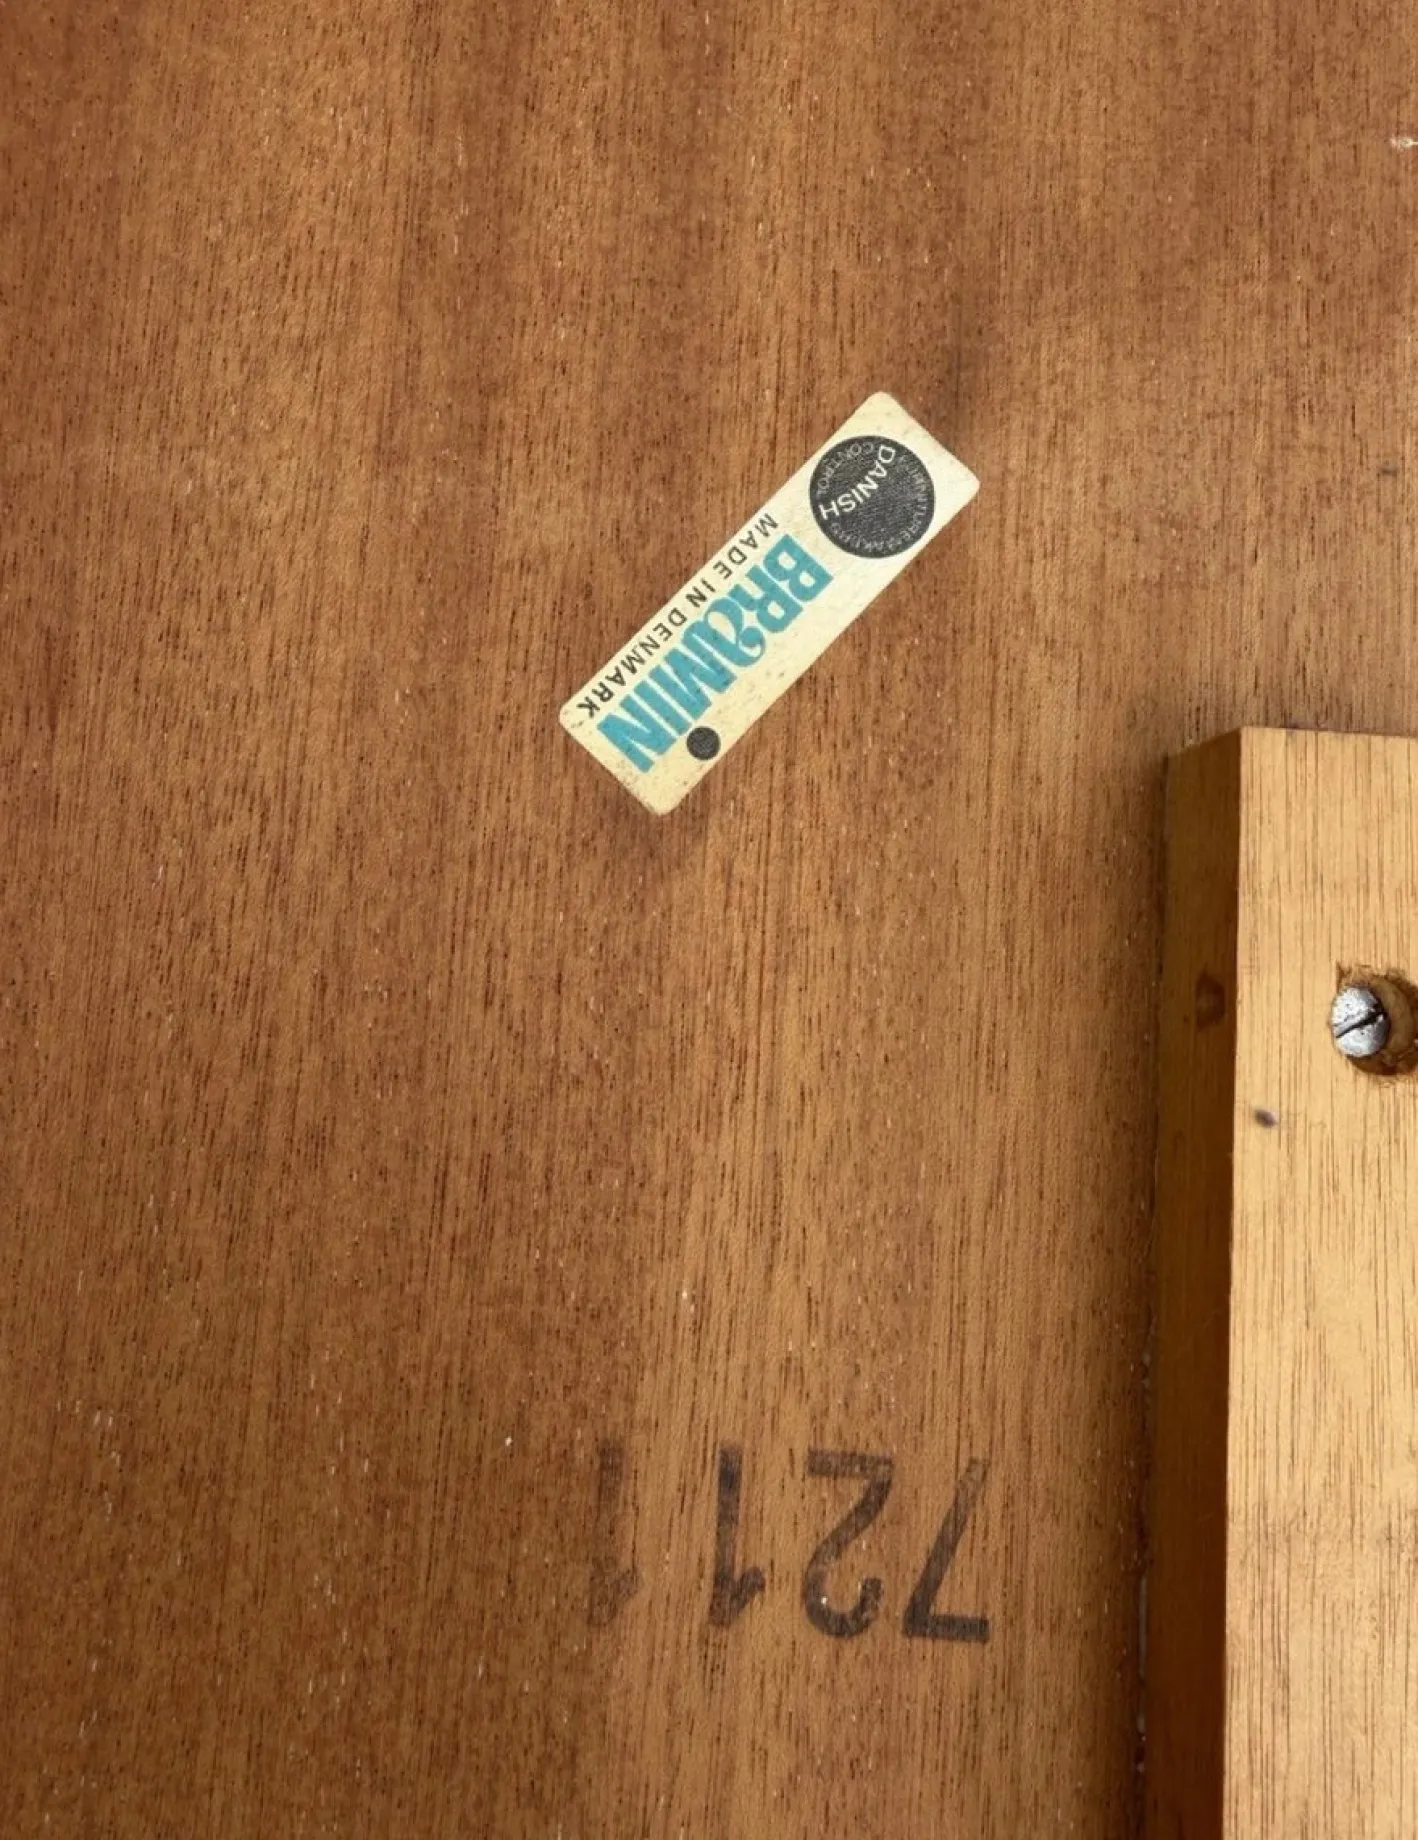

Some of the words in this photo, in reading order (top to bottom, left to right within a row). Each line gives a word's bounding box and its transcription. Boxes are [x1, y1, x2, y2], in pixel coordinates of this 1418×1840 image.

[818, 444, 896, 520] DANISH
[712, 513, 779, 580] MADE
[686, 584, 716, 609] IN
[577, 610, 688, 719] DENMARK
